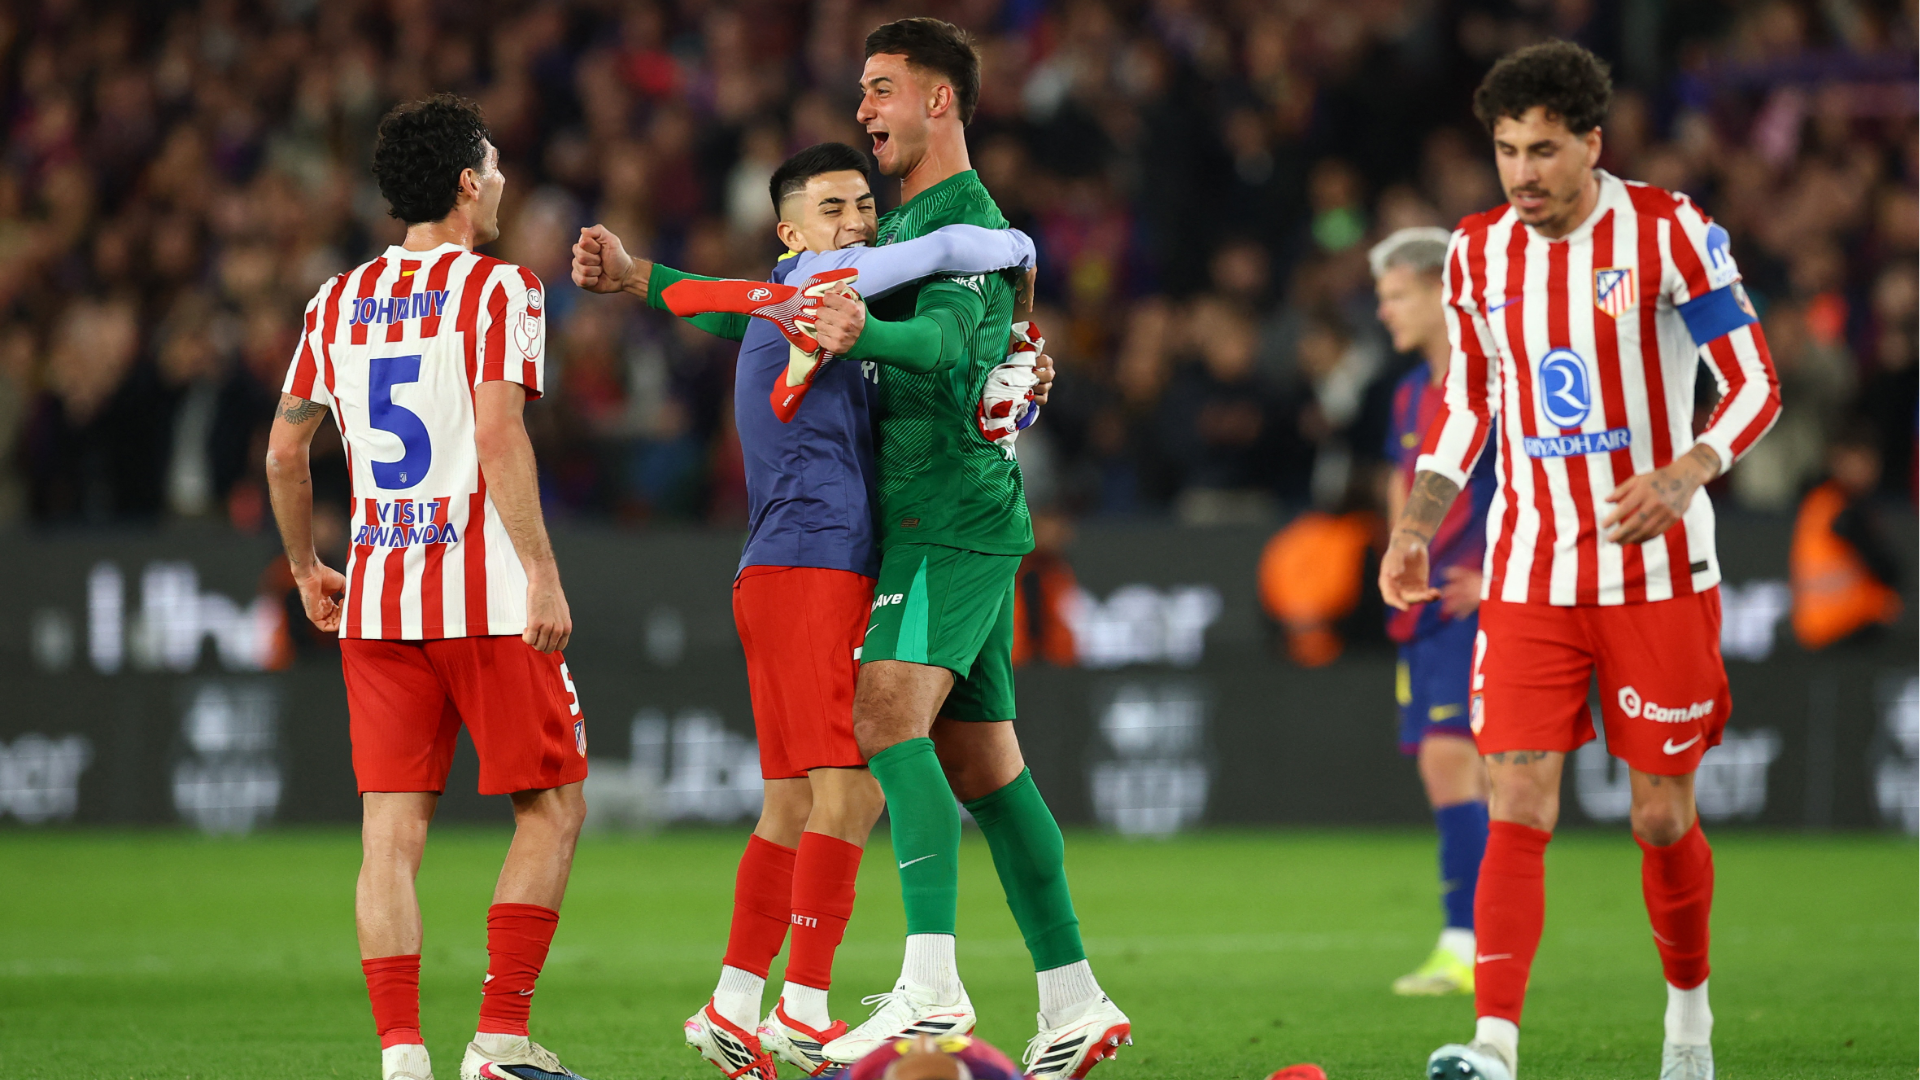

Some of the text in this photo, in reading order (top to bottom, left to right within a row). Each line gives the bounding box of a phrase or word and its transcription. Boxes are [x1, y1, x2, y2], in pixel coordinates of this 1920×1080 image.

[349, 290, 450, 325] JOHNNY
[369, 355, 432, 490] 5
[1596, 428, 1630, 450] AIR
[376, 502, 440, 524] VISIT
[353, 522, 459, 547] RWANDA
[560, 660, 580, 716] 5
[1643, 699, 1714, 723] ComAve
[791, 913, 818, 928] TLETI
